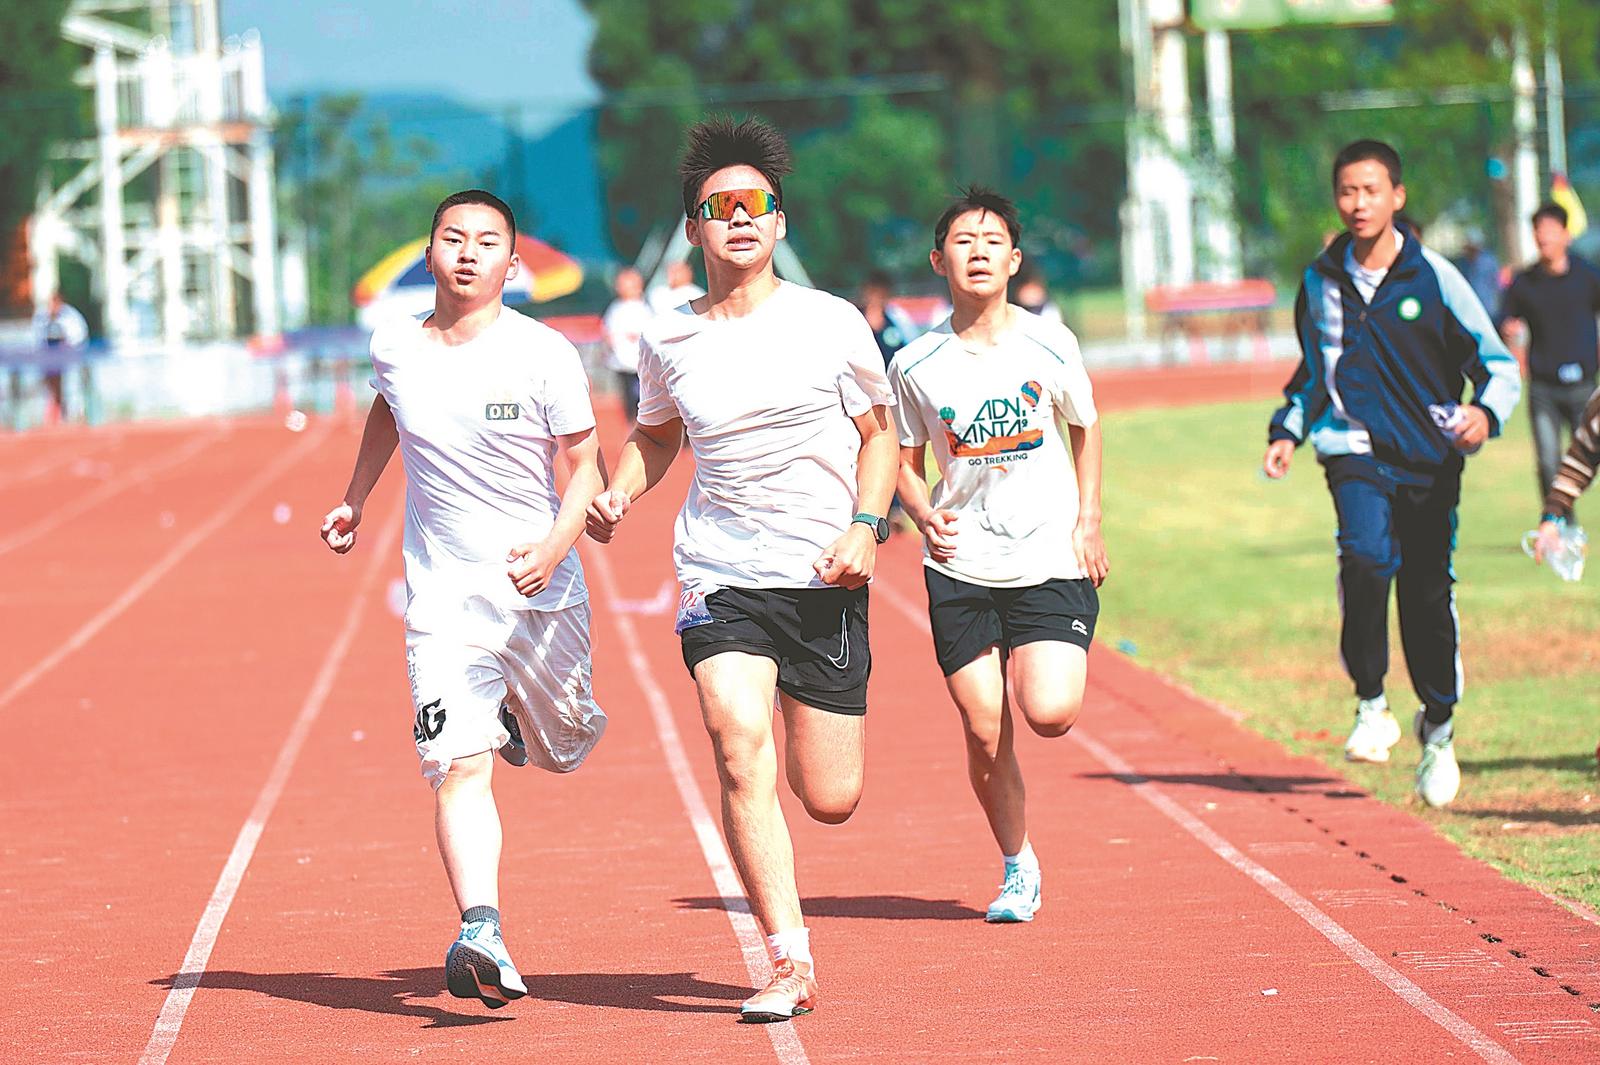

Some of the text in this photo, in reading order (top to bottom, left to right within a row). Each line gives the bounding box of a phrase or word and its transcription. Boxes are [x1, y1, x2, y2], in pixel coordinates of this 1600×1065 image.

[489, 404, 517, 419] OK
[968, 453, 1029, 466] GO TREKKING
